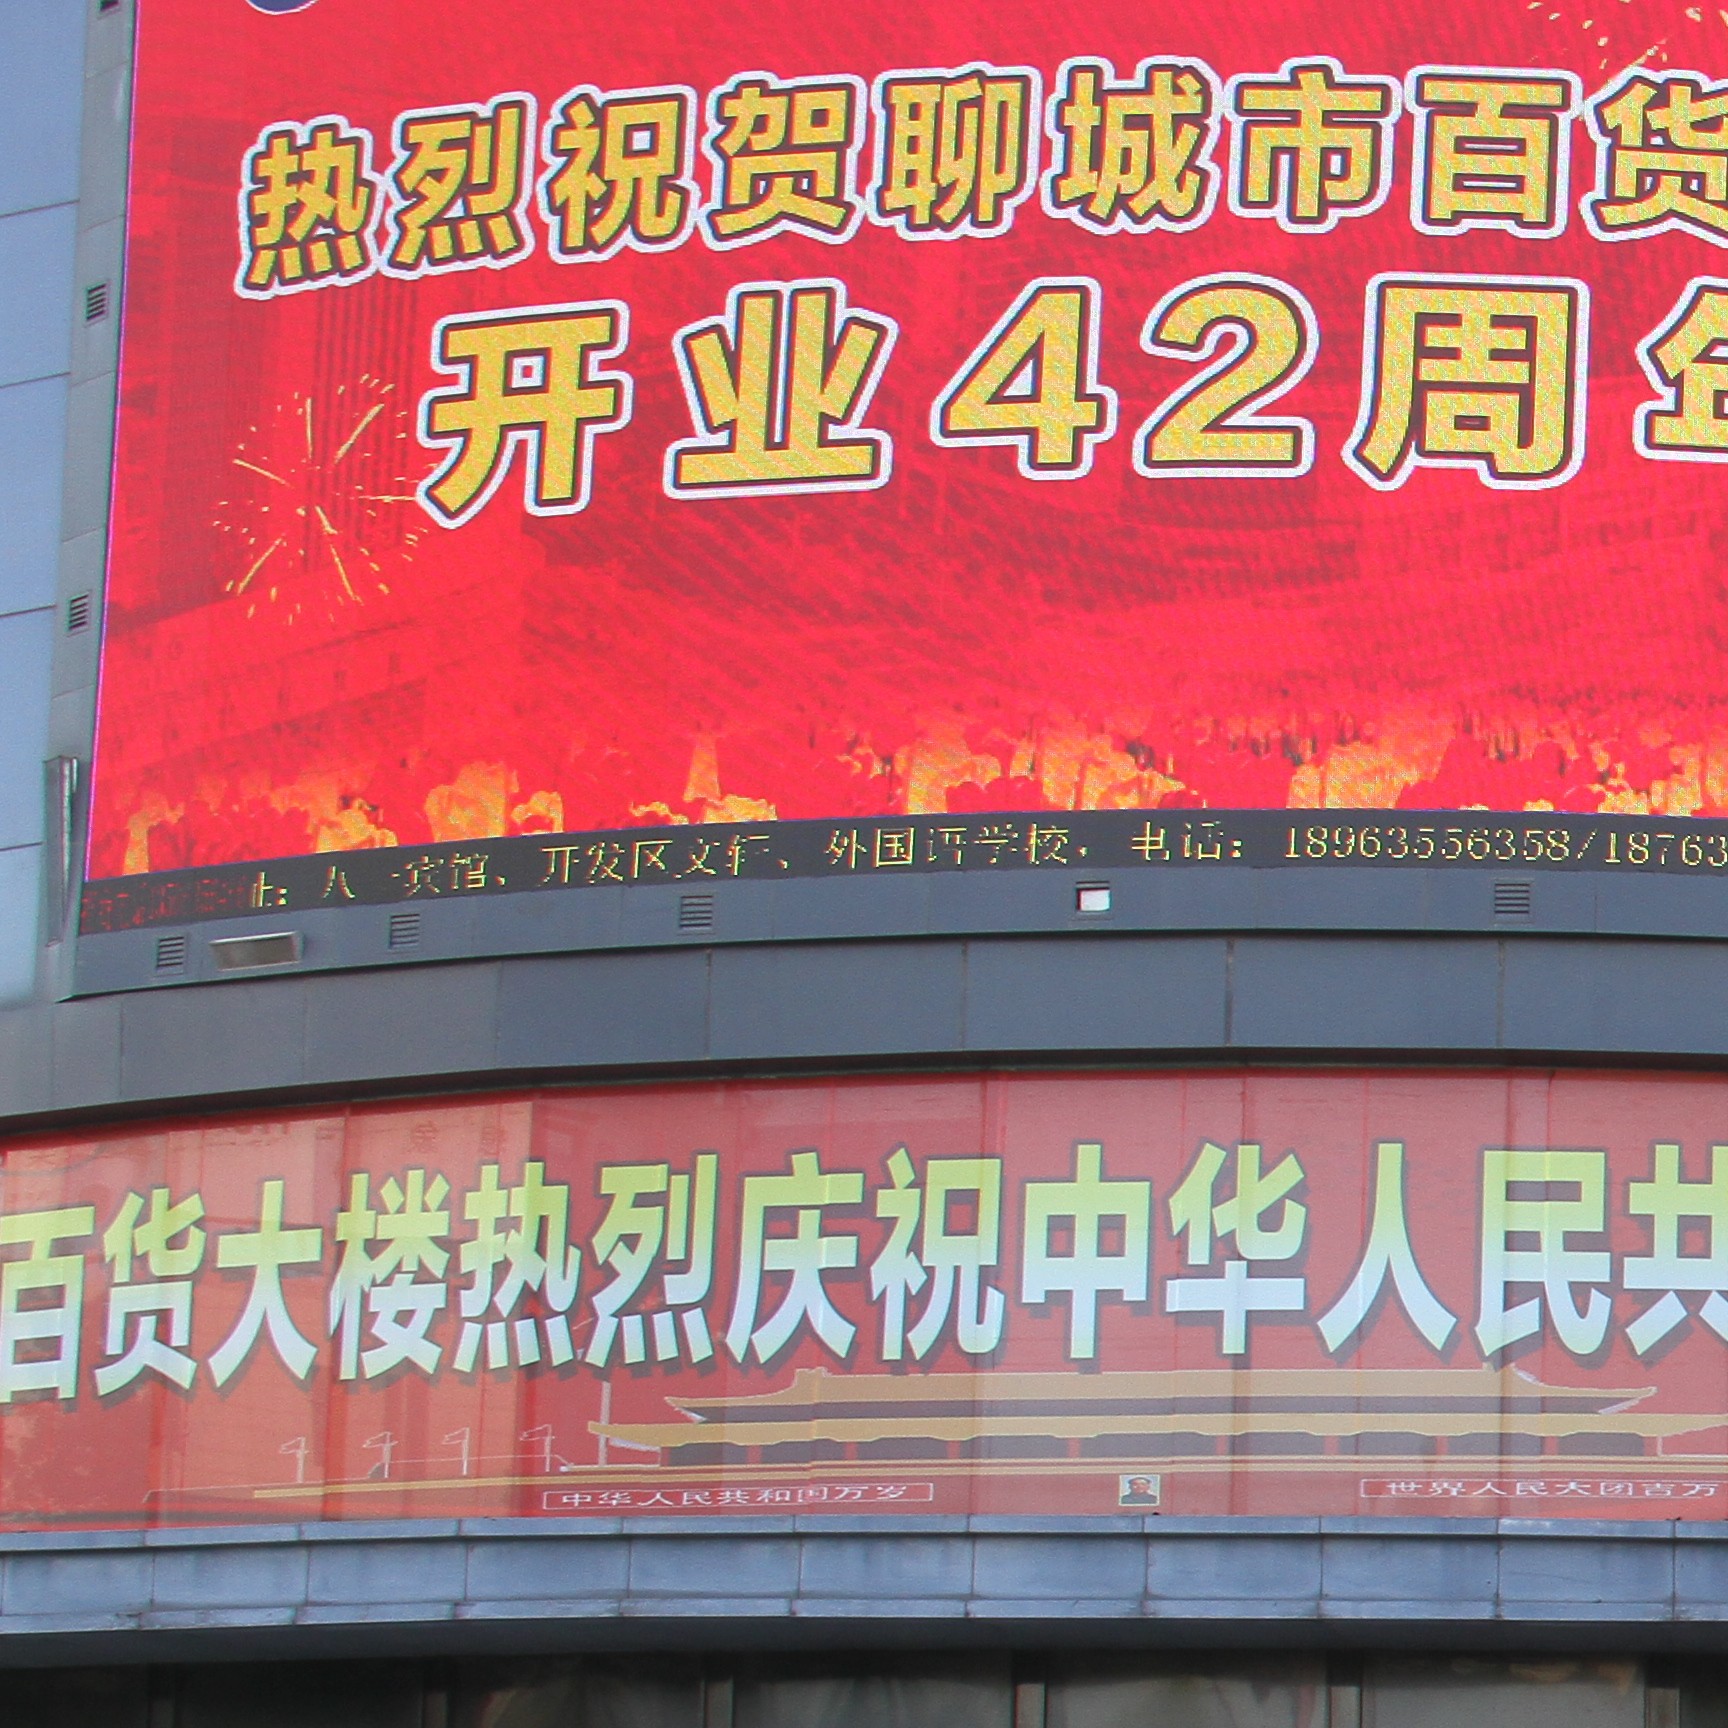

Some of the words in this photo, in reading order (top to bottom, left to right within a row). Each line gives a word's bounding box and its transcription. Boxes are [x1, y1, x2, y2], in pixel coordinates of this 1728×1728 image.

[561, 1484, 908, 1508] 中华人民共和国万岁
